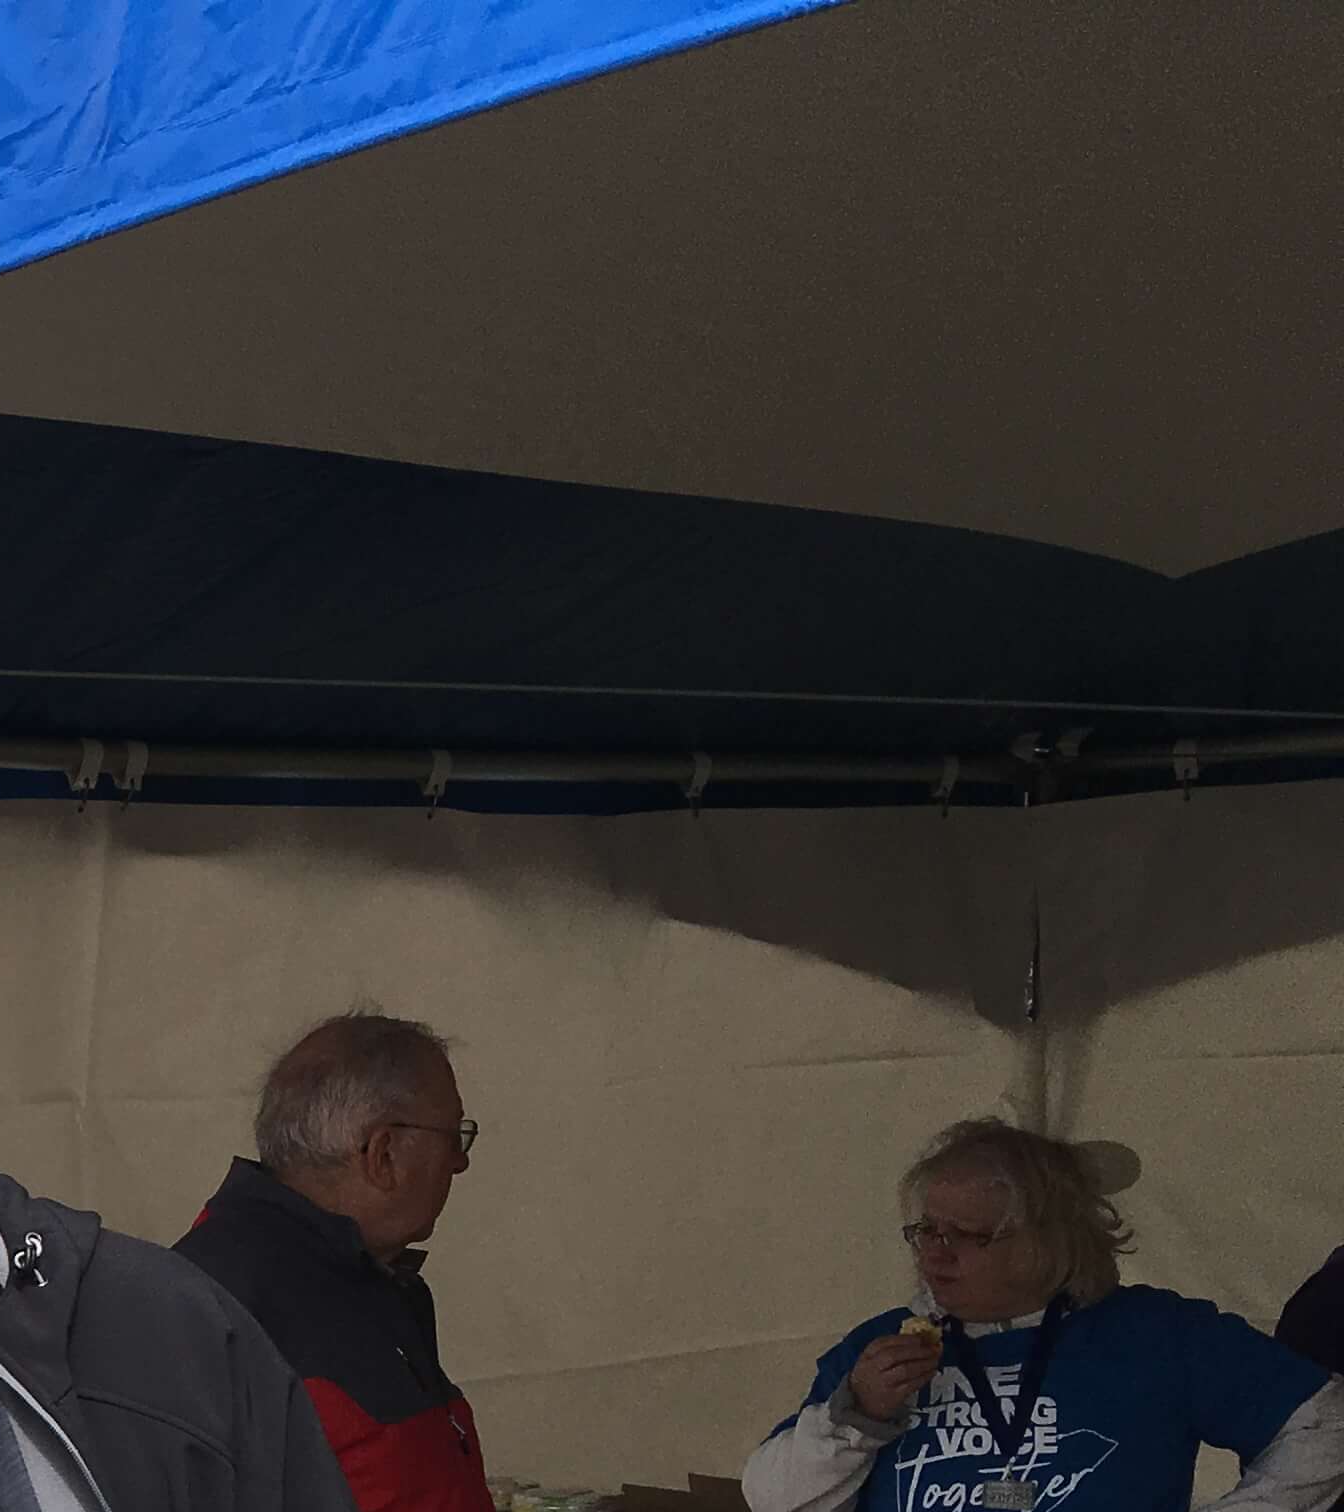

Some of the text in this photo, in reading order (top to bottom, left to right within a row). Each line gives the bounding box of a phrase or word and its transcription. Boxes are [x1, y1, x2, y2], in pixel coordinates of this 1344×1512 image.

[929, 1363, 1022, 1403] NE
[908, 1396, 1057, 1429] TRG
[936, 1426, 1058, 1456] VOE
